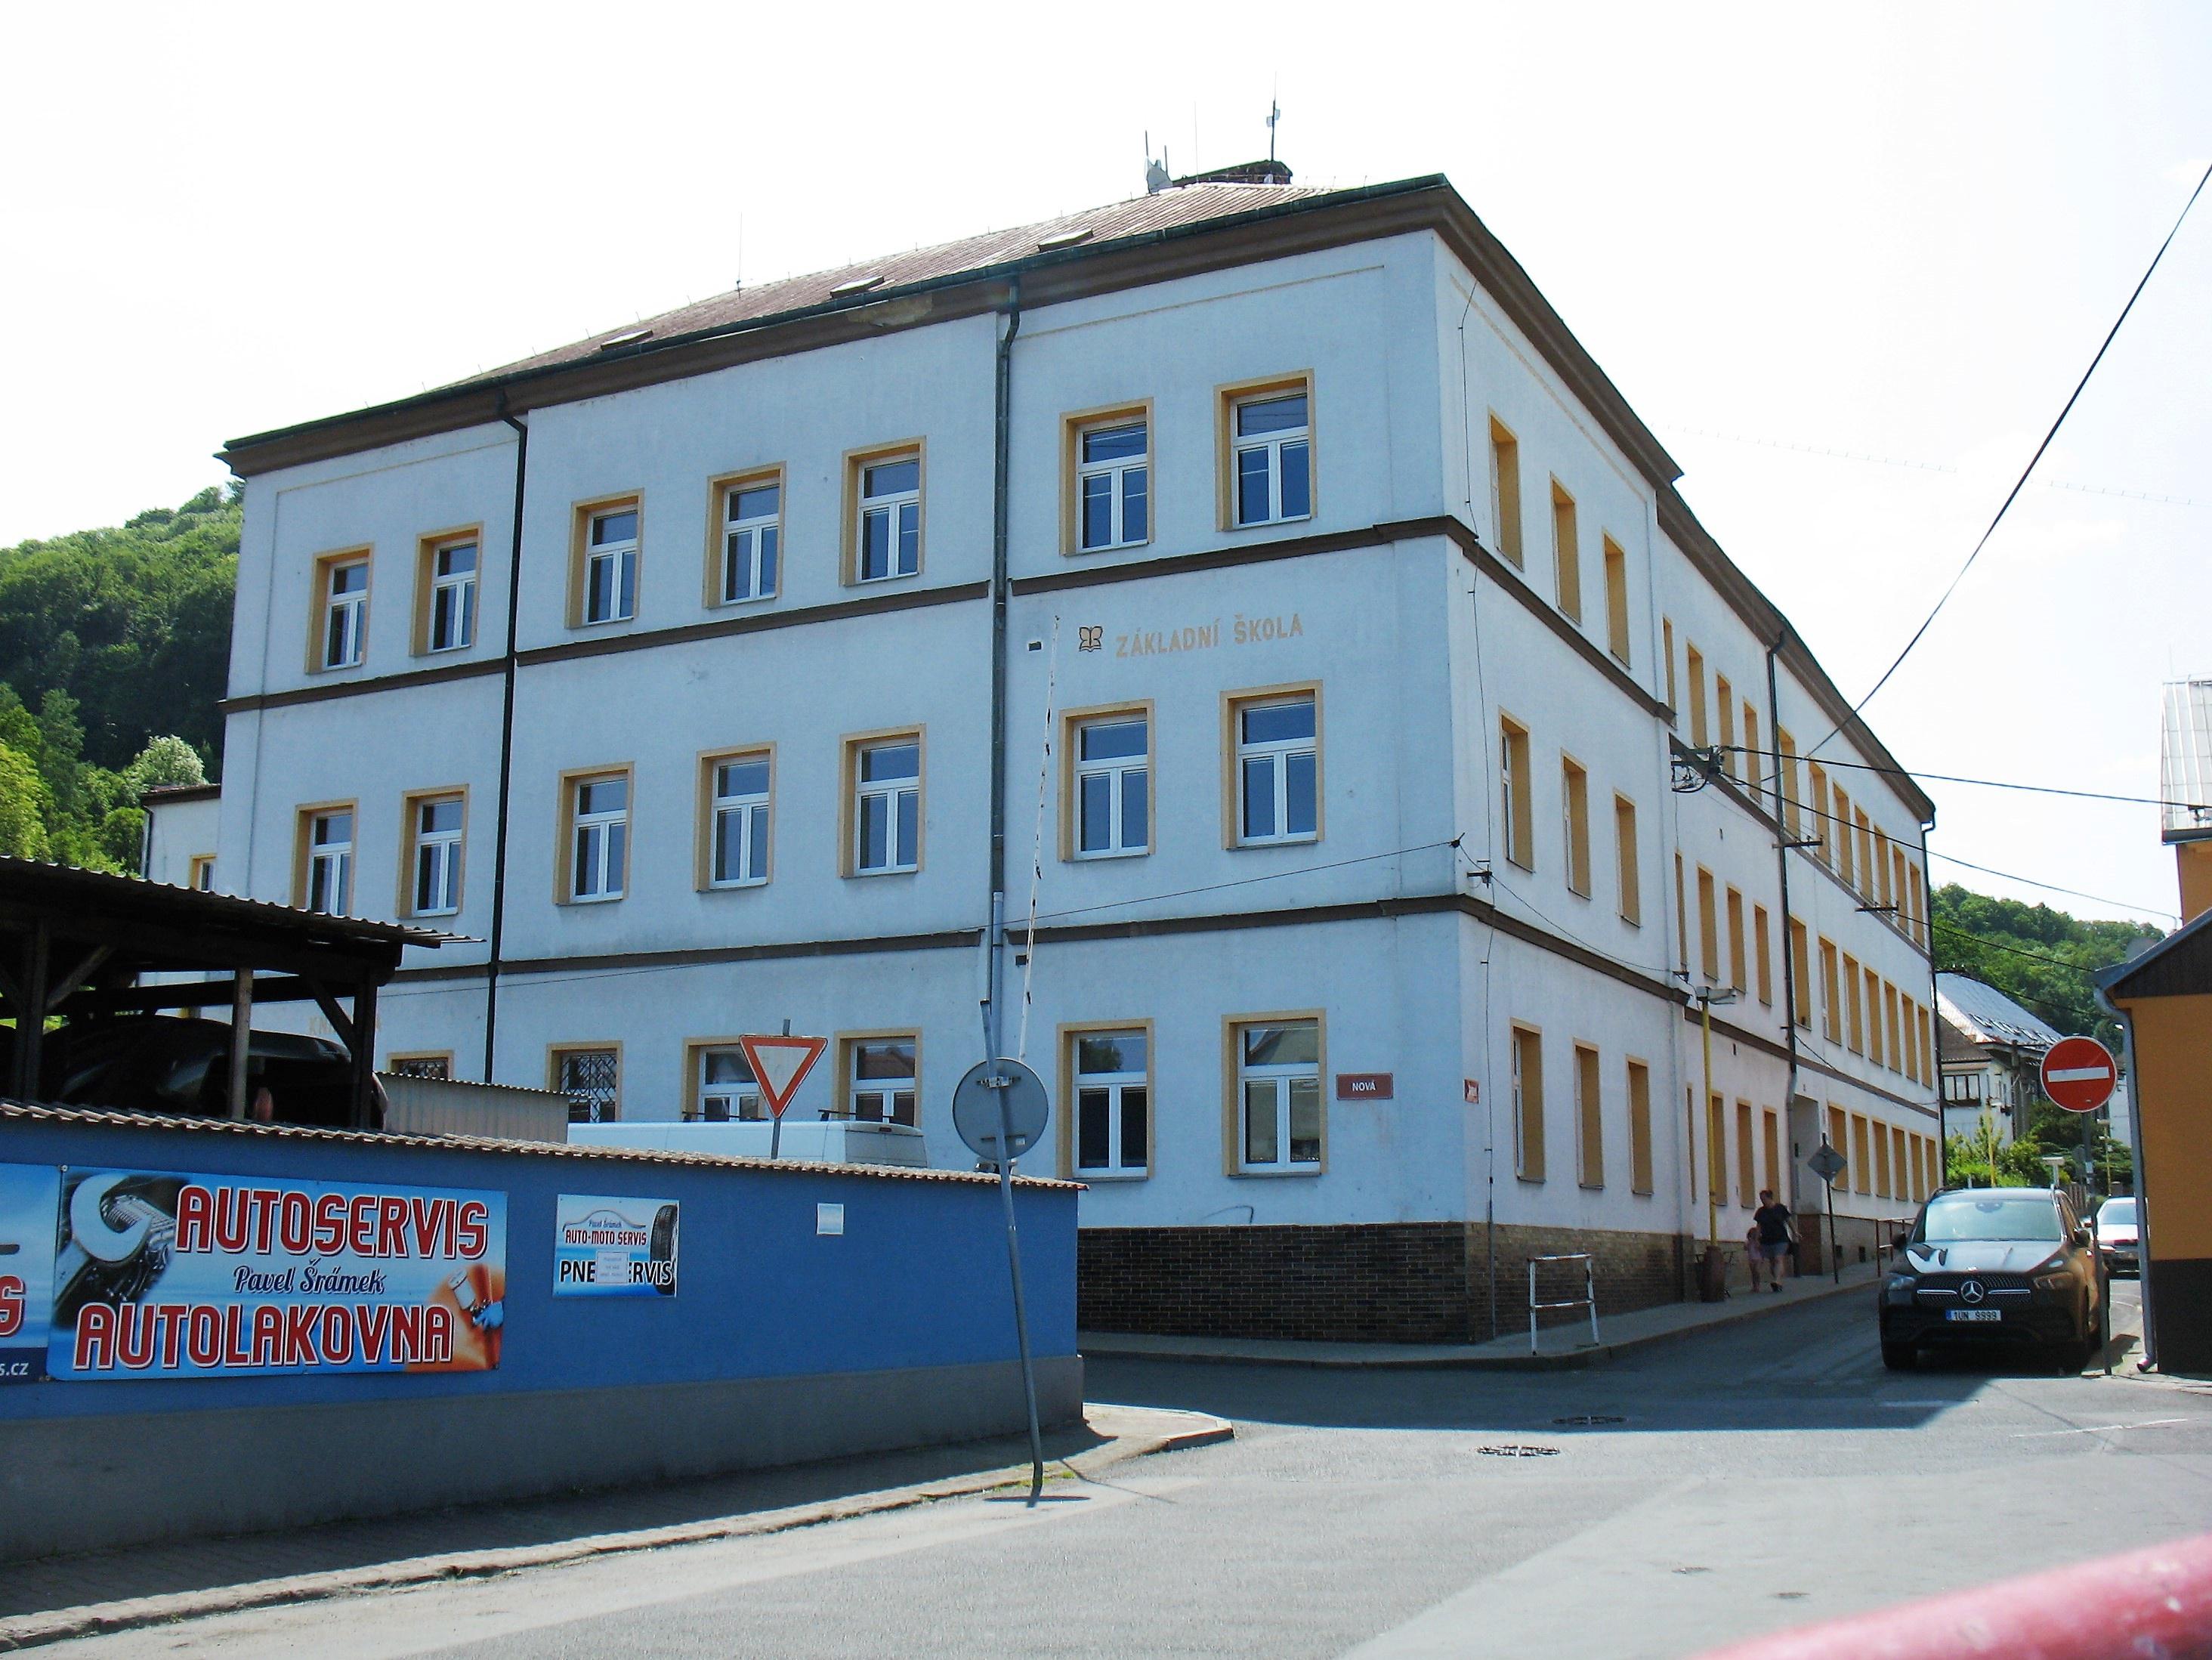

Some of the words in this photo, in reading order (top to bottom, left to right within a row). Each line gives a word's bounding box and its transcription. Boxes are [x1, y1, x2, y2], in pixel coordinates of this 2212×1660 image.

[1115, 617, 1220, 658] ZÁKLADNÍ
[1233, 612, 1304, 645] ŠKOLA
[1352, 1080, 1376, 1092] NOVÁ
[175, 1185, 490, 1260] AUTOSERVIS
[565, 1229, 616, 1245] AUTO-MOTO
[617, 1231, 647, 1246] SERVIS
[233, 1265, 296, 1294] Pavel
[300, 1257, 388, 1294] Šrámek
[559, 1260, 673, 1284] PNERVIS
[73, 1301, 454, 1371] AUTOLAKOVNA
